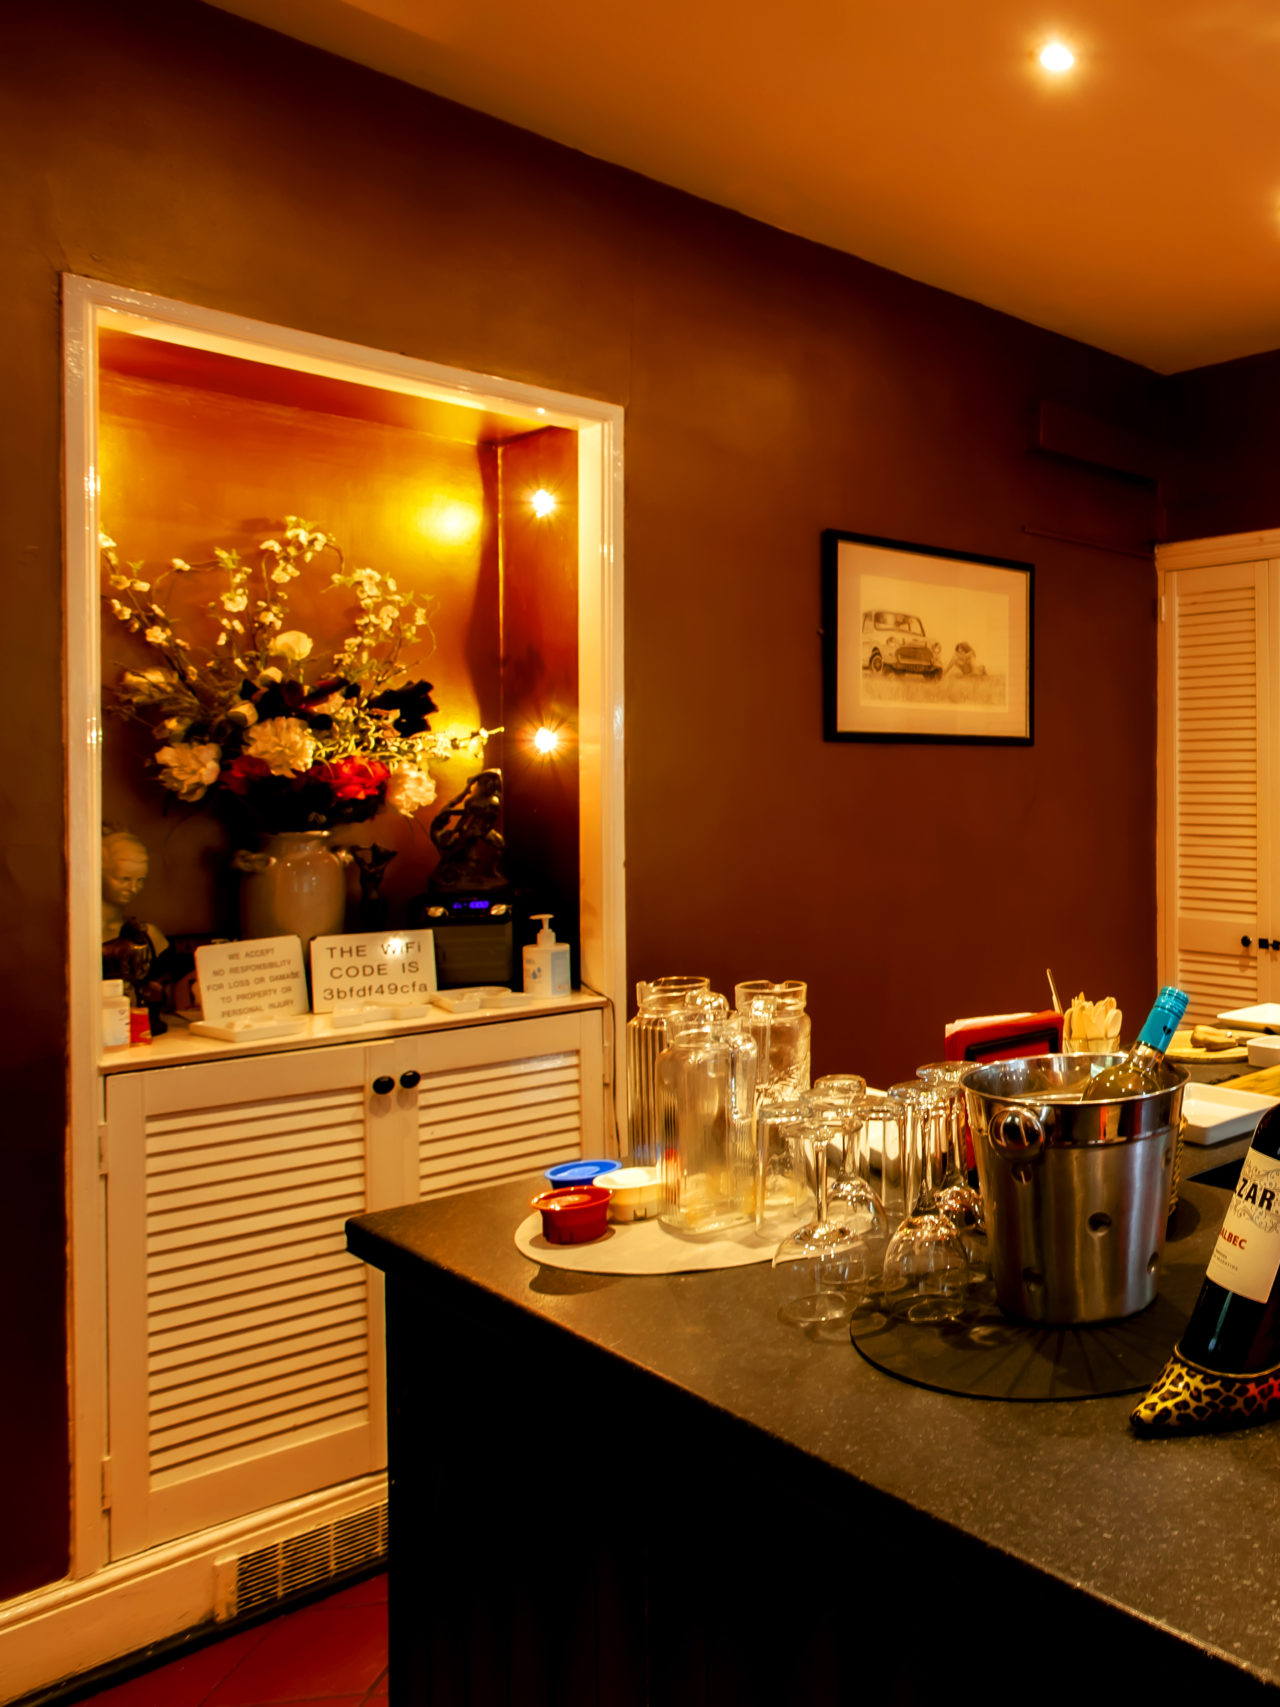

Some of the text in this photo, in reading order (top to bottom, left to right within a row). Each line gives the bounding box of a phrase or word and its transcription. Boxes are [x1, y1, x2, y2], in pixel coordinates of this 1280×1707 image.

[244, 948, 275, 958] ACCEPT
[326, 944, 368, 959] THE
[212, 960, 292, 977] NO RESPONSIBILITY
[329, 961, 419, 979] CODE IS
[207, 983, 225, 991] FOR
[228, 979, 250, 989] LOSS
[253, 976, 265, 985] OR
[323, 981, 428, 1001] 3bfdf49cfa
[236, 988, 278, 1001] PROPERTY
[281, 986, 292, 994] OR
[221, 999, 294, 1018] PERSONAL INJURY
[1235, 1178, 1276, 1211] ZAR
